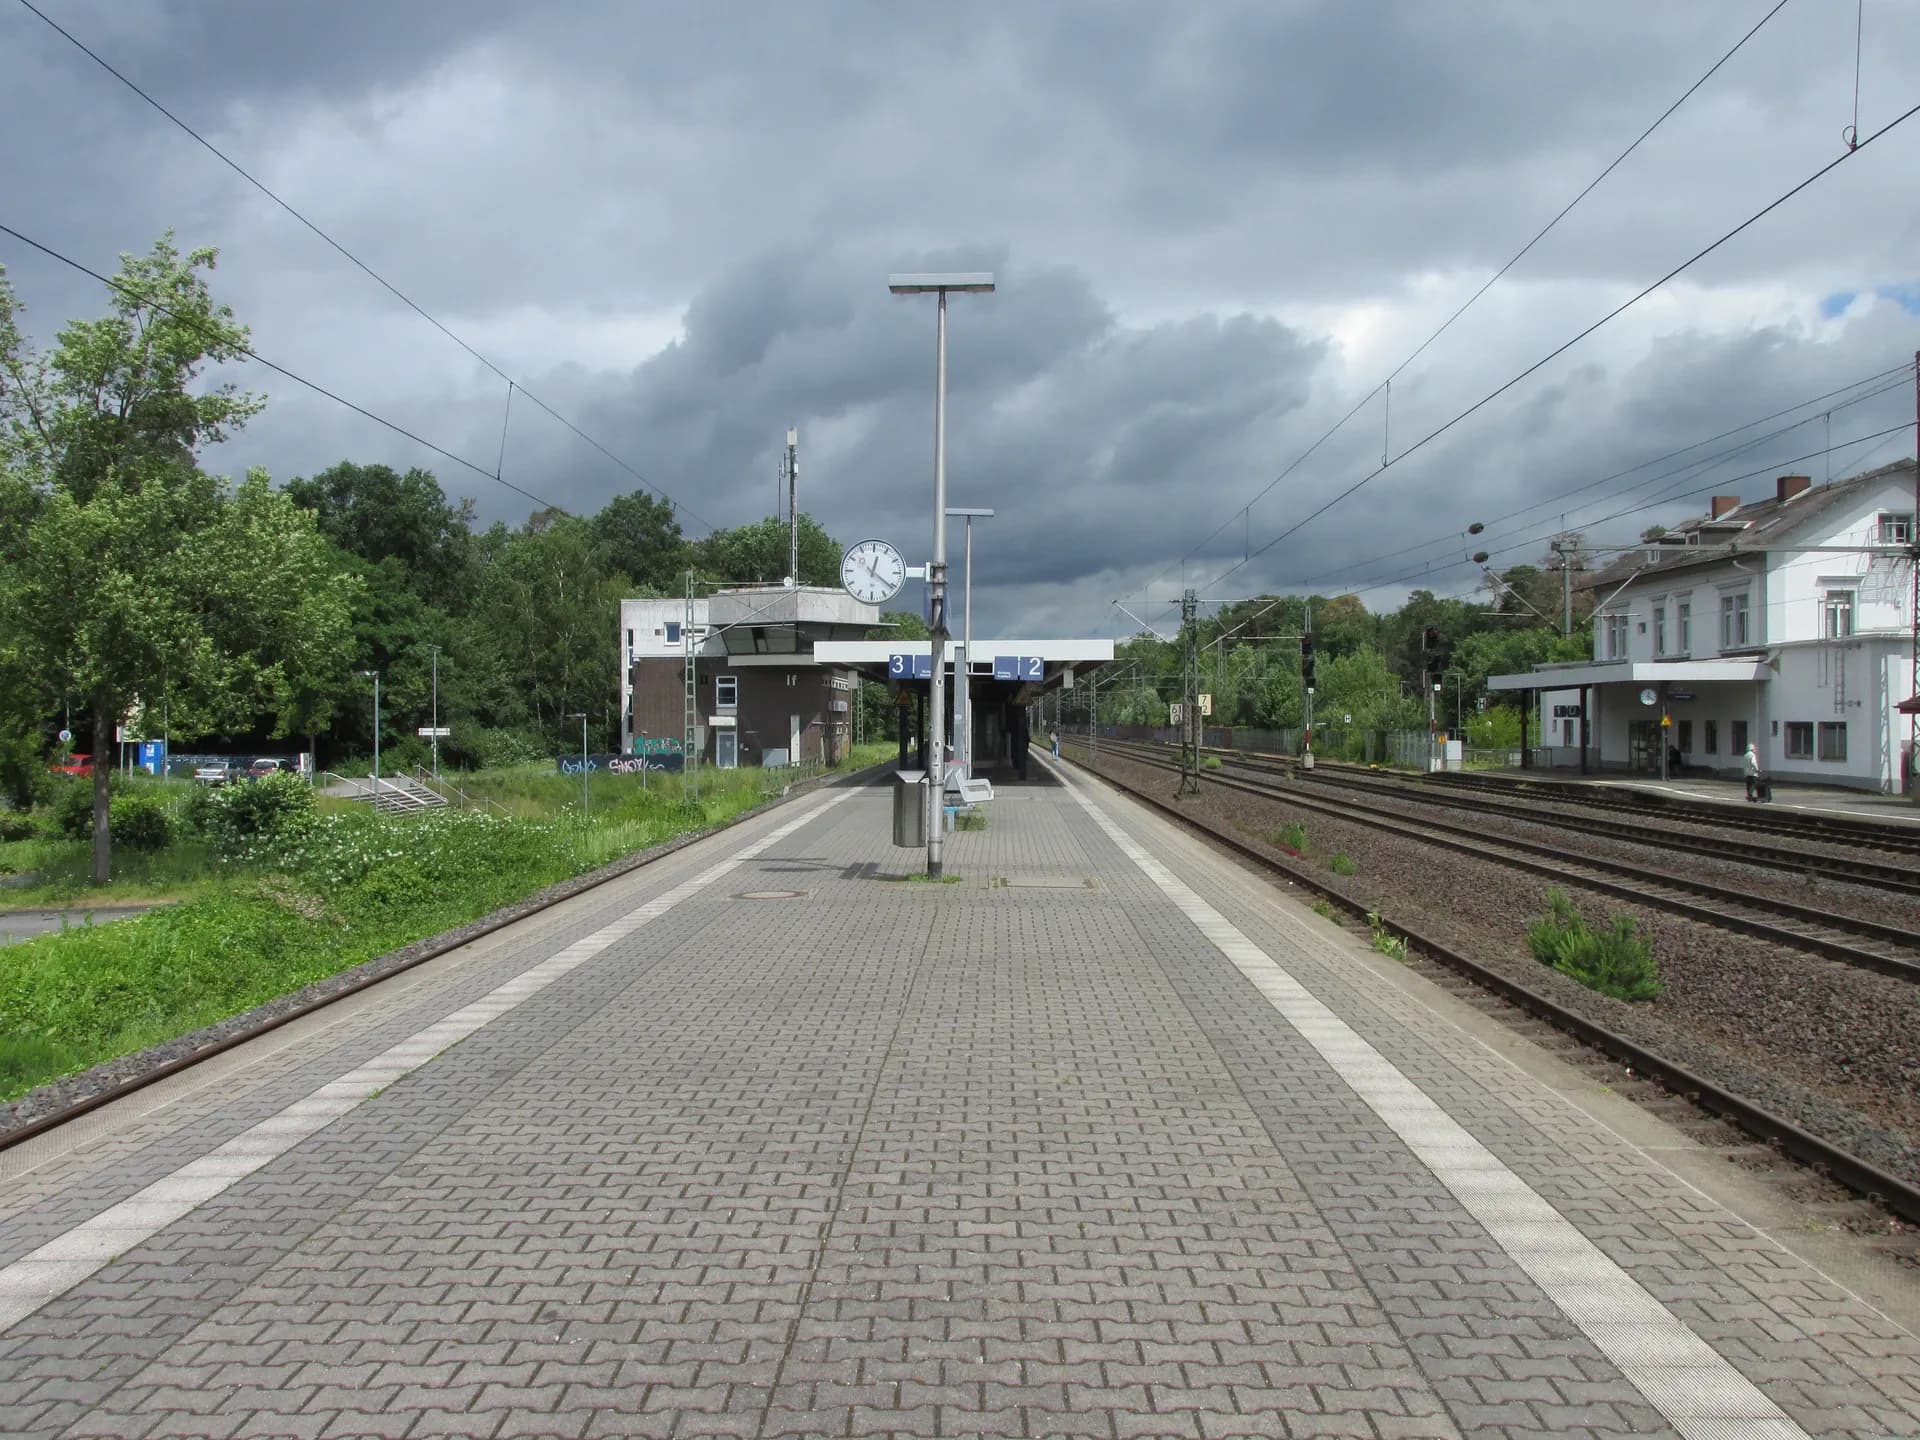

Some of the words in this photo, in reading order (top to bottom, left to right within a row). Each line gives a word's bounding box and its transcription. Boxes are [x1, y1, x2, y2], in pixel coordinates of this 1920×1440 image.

[892, 655, 903, 673] 3
[1029, 657, 1040, 675] 2
[1202, 696, 1207, 704] 7
[1202, 705, 1208, 713] 2
